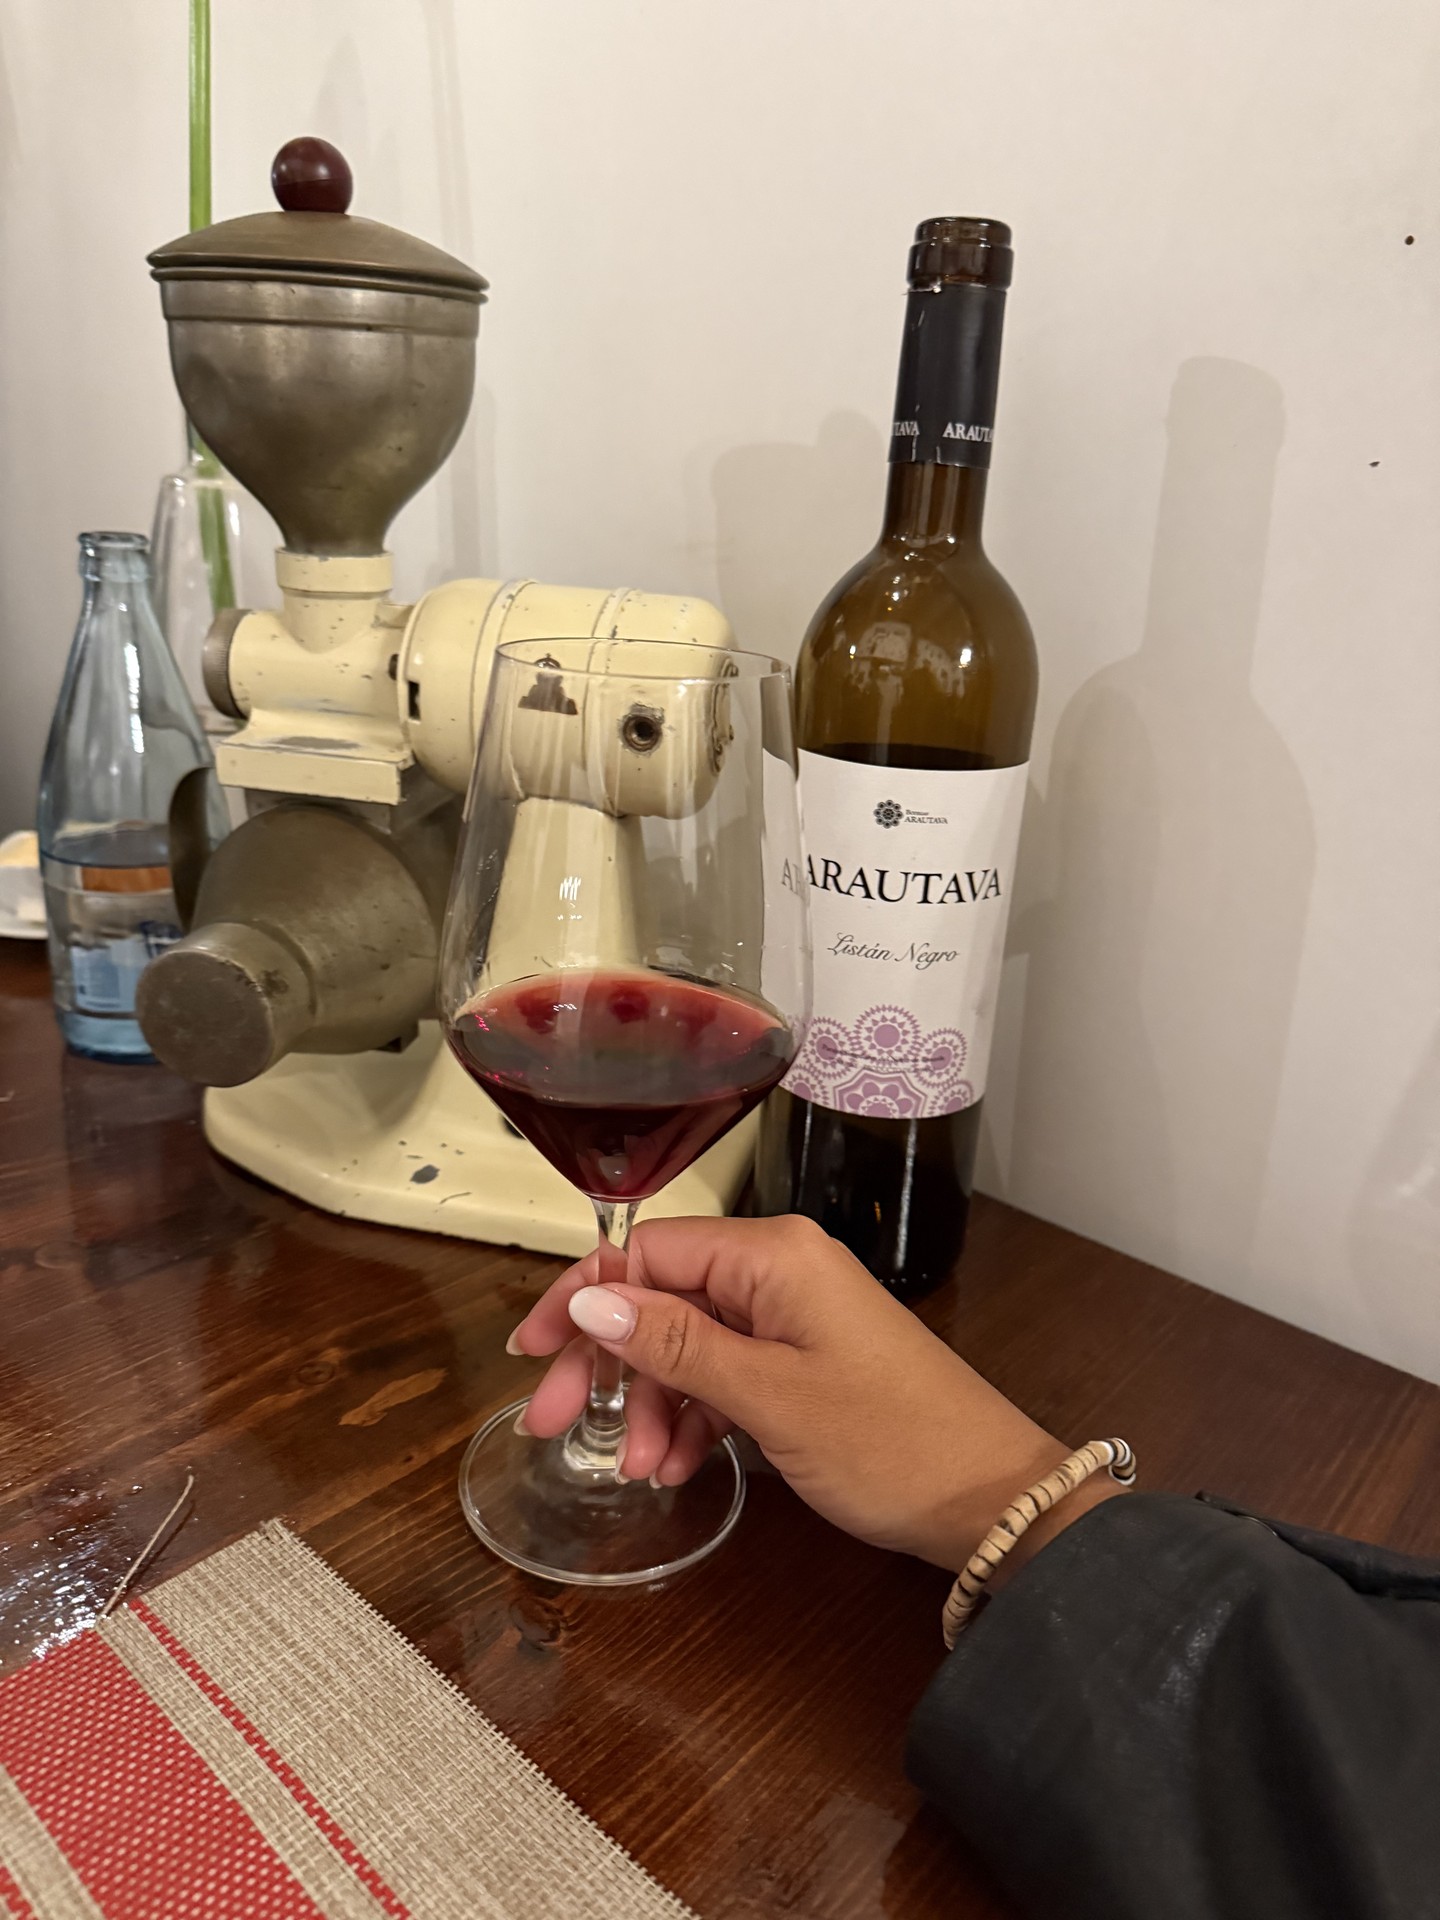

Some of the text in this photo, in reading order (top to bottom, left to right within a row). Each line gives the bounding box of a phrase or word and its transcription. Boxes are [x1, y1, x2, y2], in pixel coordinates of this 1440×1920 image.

[893, 421, 920, 437] TAVA
[807, 854, 1002, 905] ARAUTAVA
[827, 932, 958, 971] Listán Negro
